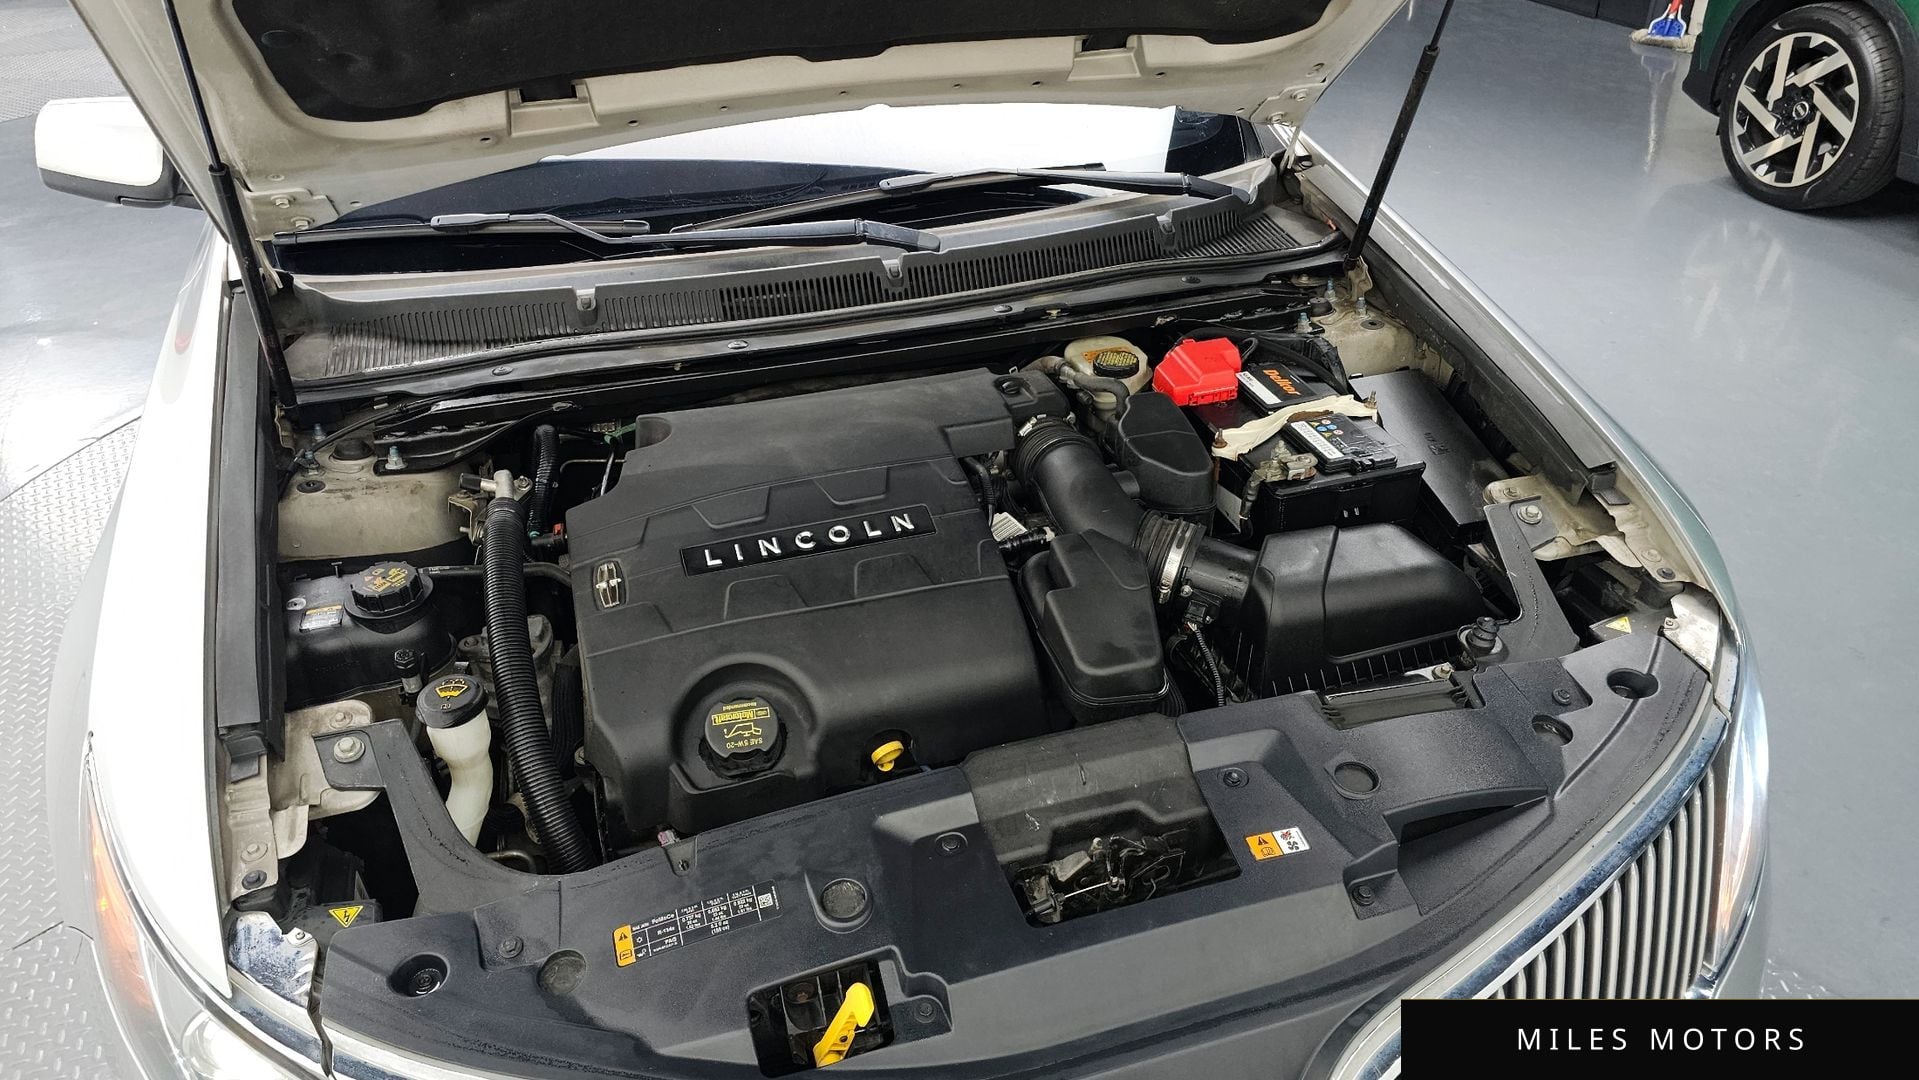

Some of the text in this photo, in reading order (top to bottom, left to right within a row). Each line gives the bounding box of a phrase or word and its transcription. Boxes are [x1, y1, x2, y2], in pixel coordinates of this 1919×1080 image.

[1263, 369, 1302, 396] Delkor
[704, 513, 915, 567] LINCOLN
[714, 710, 755, 724] Motorcraft
[726, 738, 763, 749] SAE 5W-20
